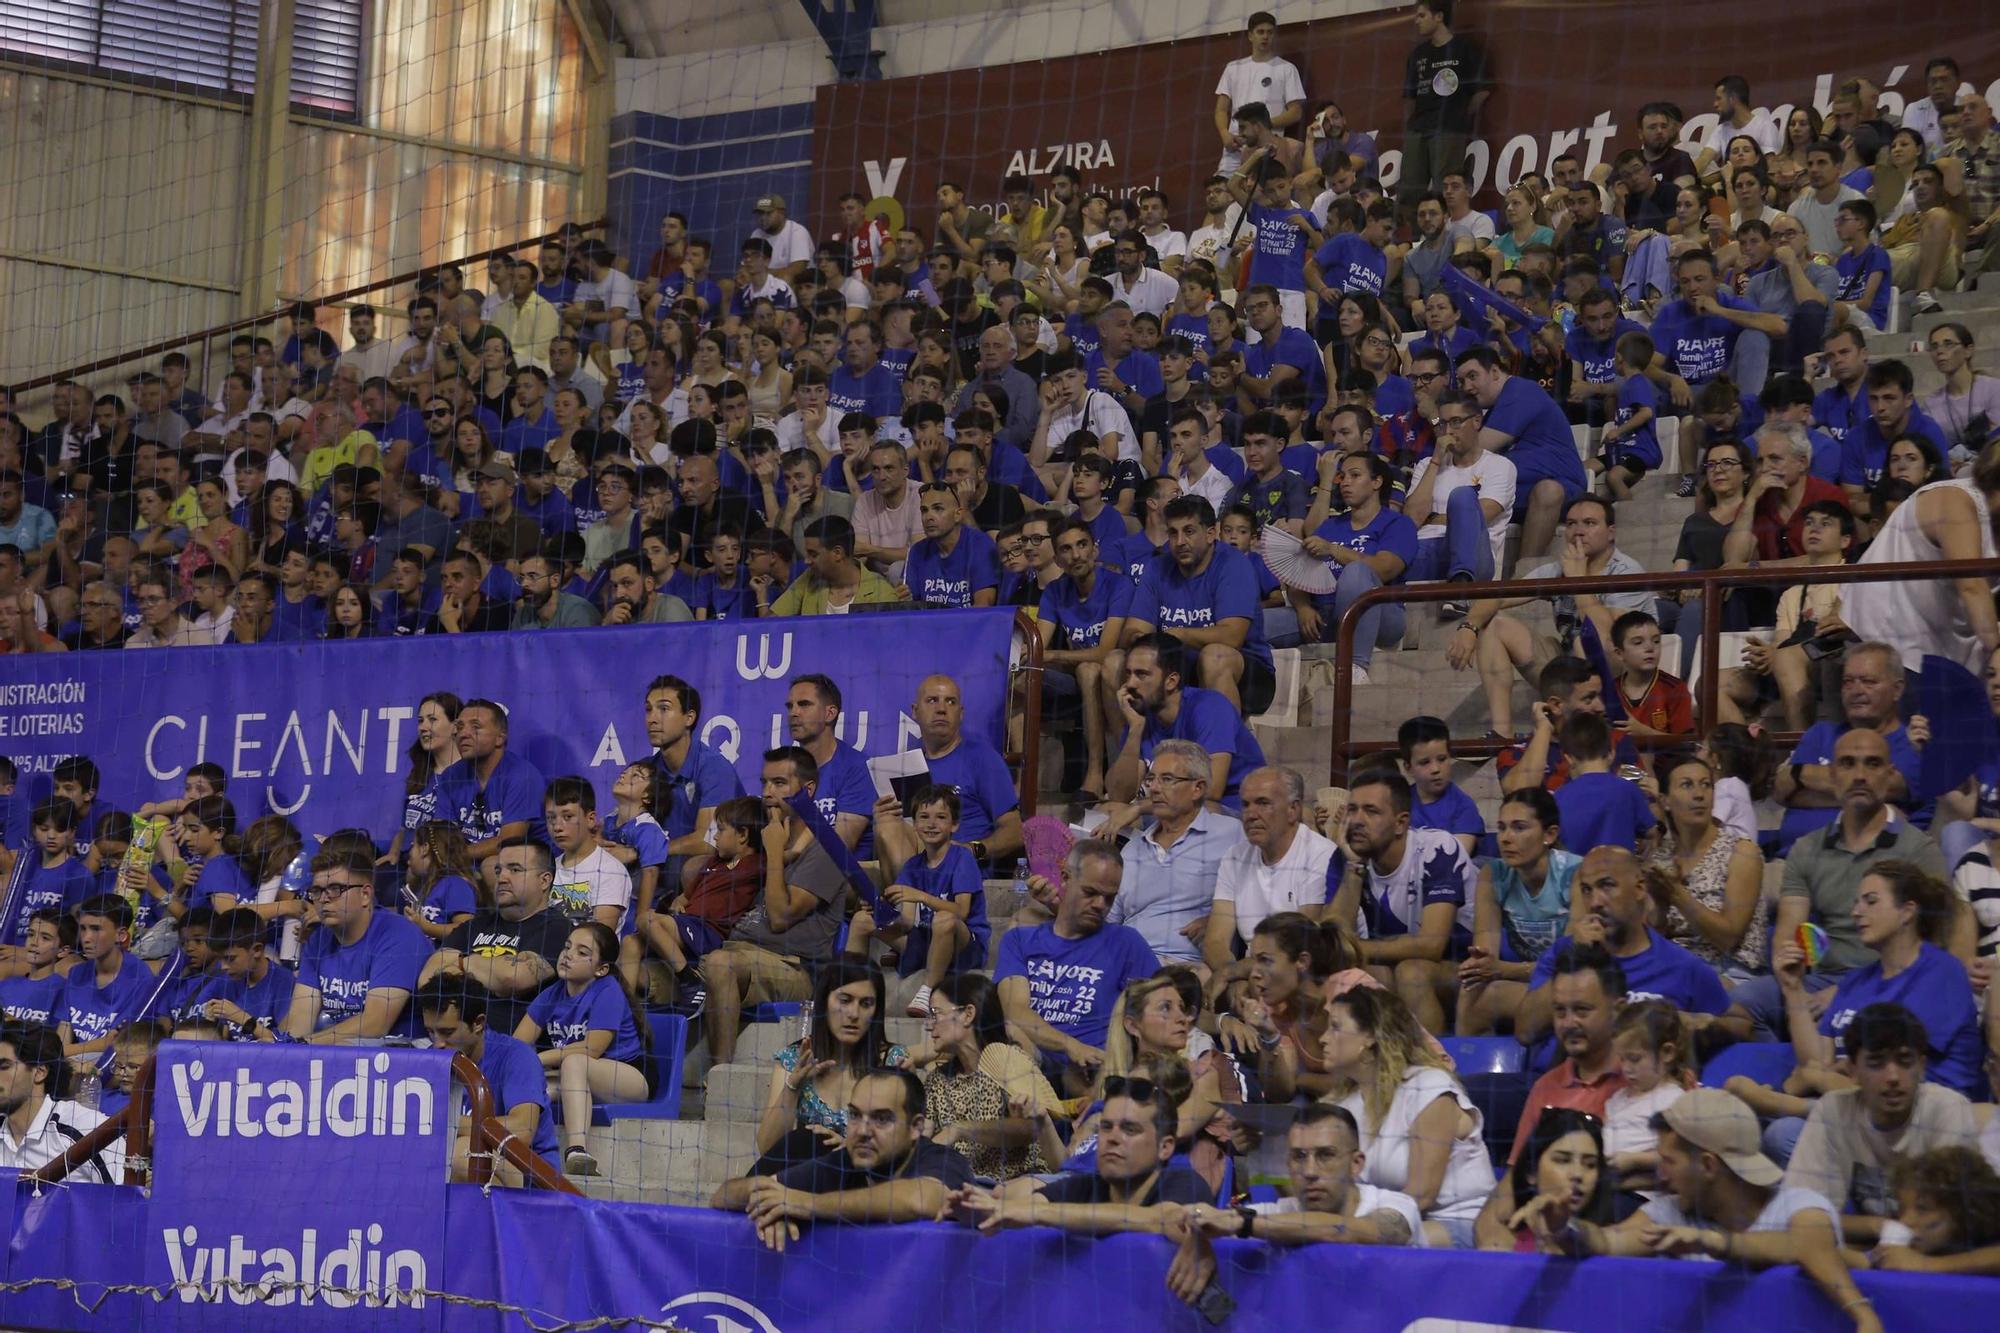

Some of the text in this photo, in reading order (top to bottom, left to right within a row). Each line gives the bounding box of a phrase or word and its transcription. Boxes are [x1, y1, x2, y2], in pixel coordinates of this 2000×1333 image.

[1004, 139, 1115, 178] ALZIRA
[1159, 605, 1213, 626] PLAYOFF
[11, 712, 84, 736] LOTERIAS
[1075, 985, 1098, 1001] 22
[1071, 999, 1093, 1015] 23
[171, 1052, 434, 1138] Vitaldin
[162, 1222, 427, 1310] Vitaldin
